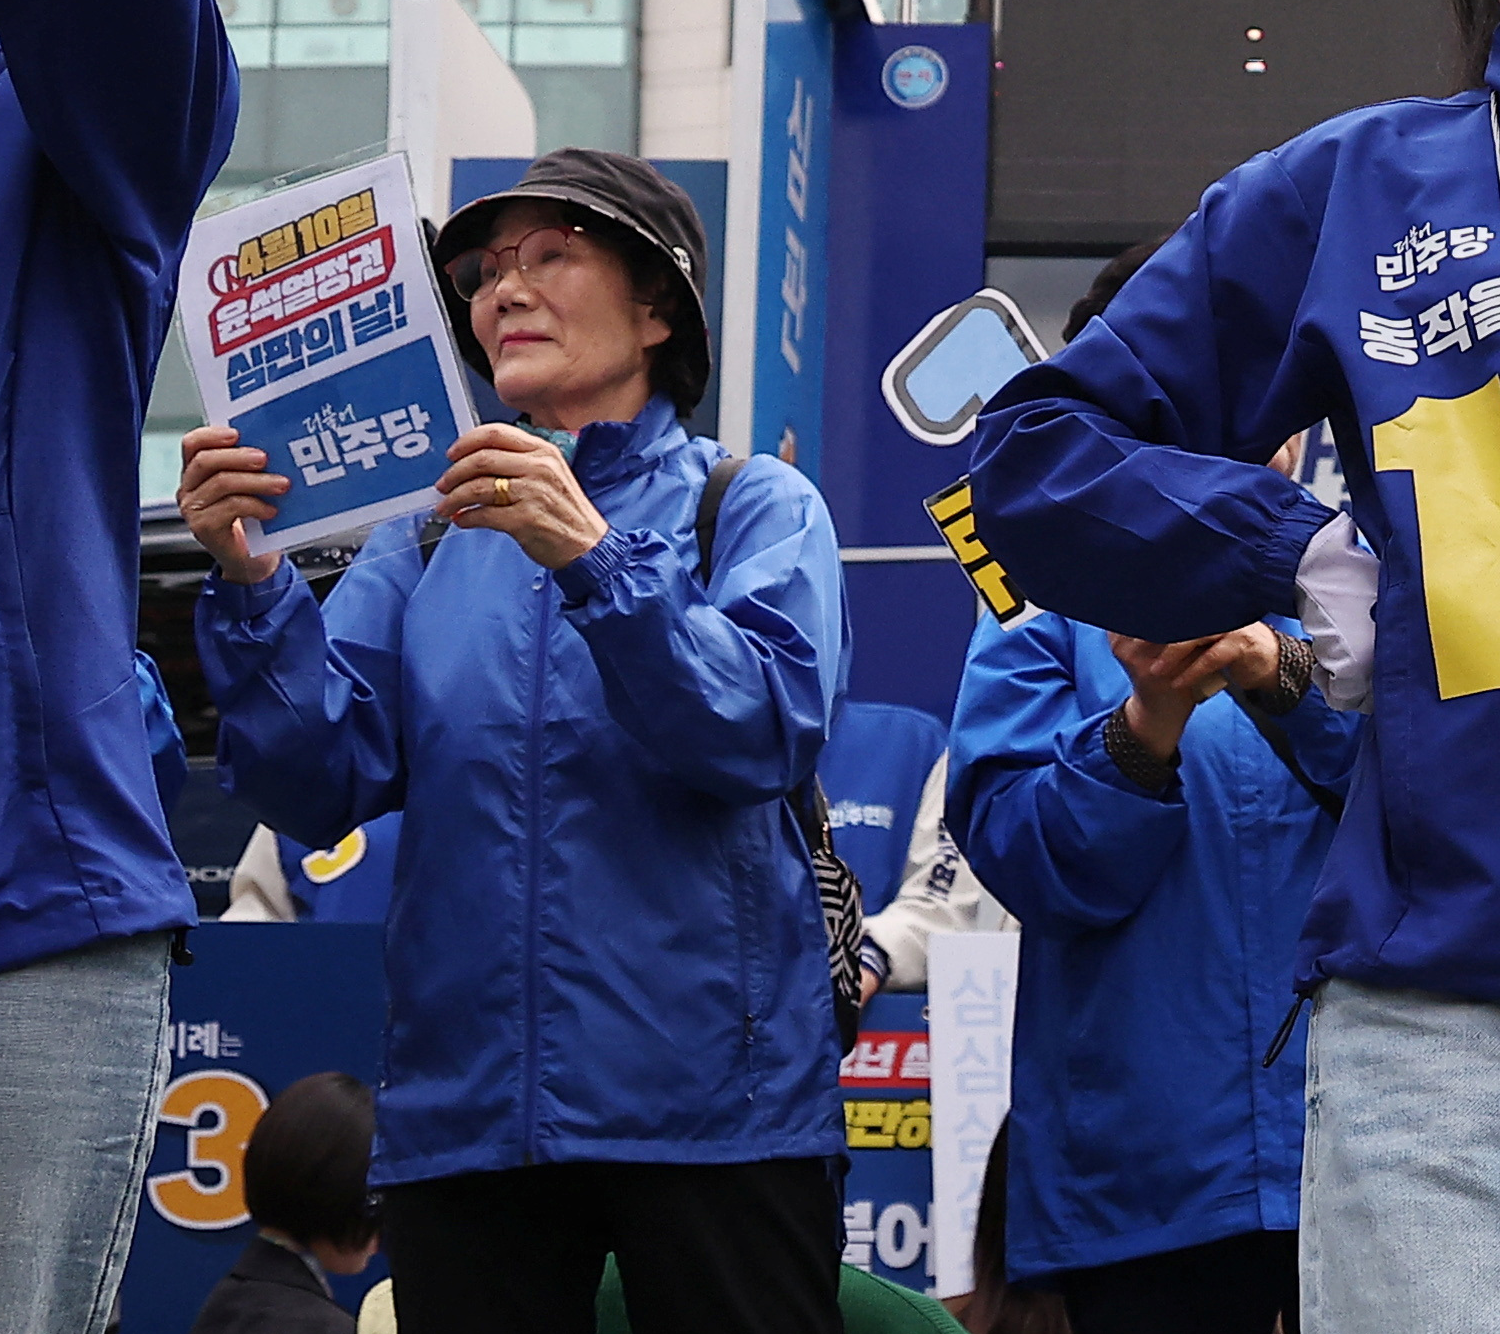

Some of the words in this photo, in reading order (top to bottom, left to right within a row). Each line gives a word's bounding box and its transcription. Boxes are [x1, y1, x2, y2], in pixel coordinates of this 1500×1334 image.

[1375, 226, 1495, 292] 민주당
[1393, 221, 1432, 254] 더불어
[215, 237, 386, 347] 윤석열정권
[226, 310, 348, 402] 심판의
[348, 282, 408, 347] 날!
[288, 403, 431, 487] 민주당
[302, 403, 356, 434] 더불어
[146, 1069, 272, 1231] 3
